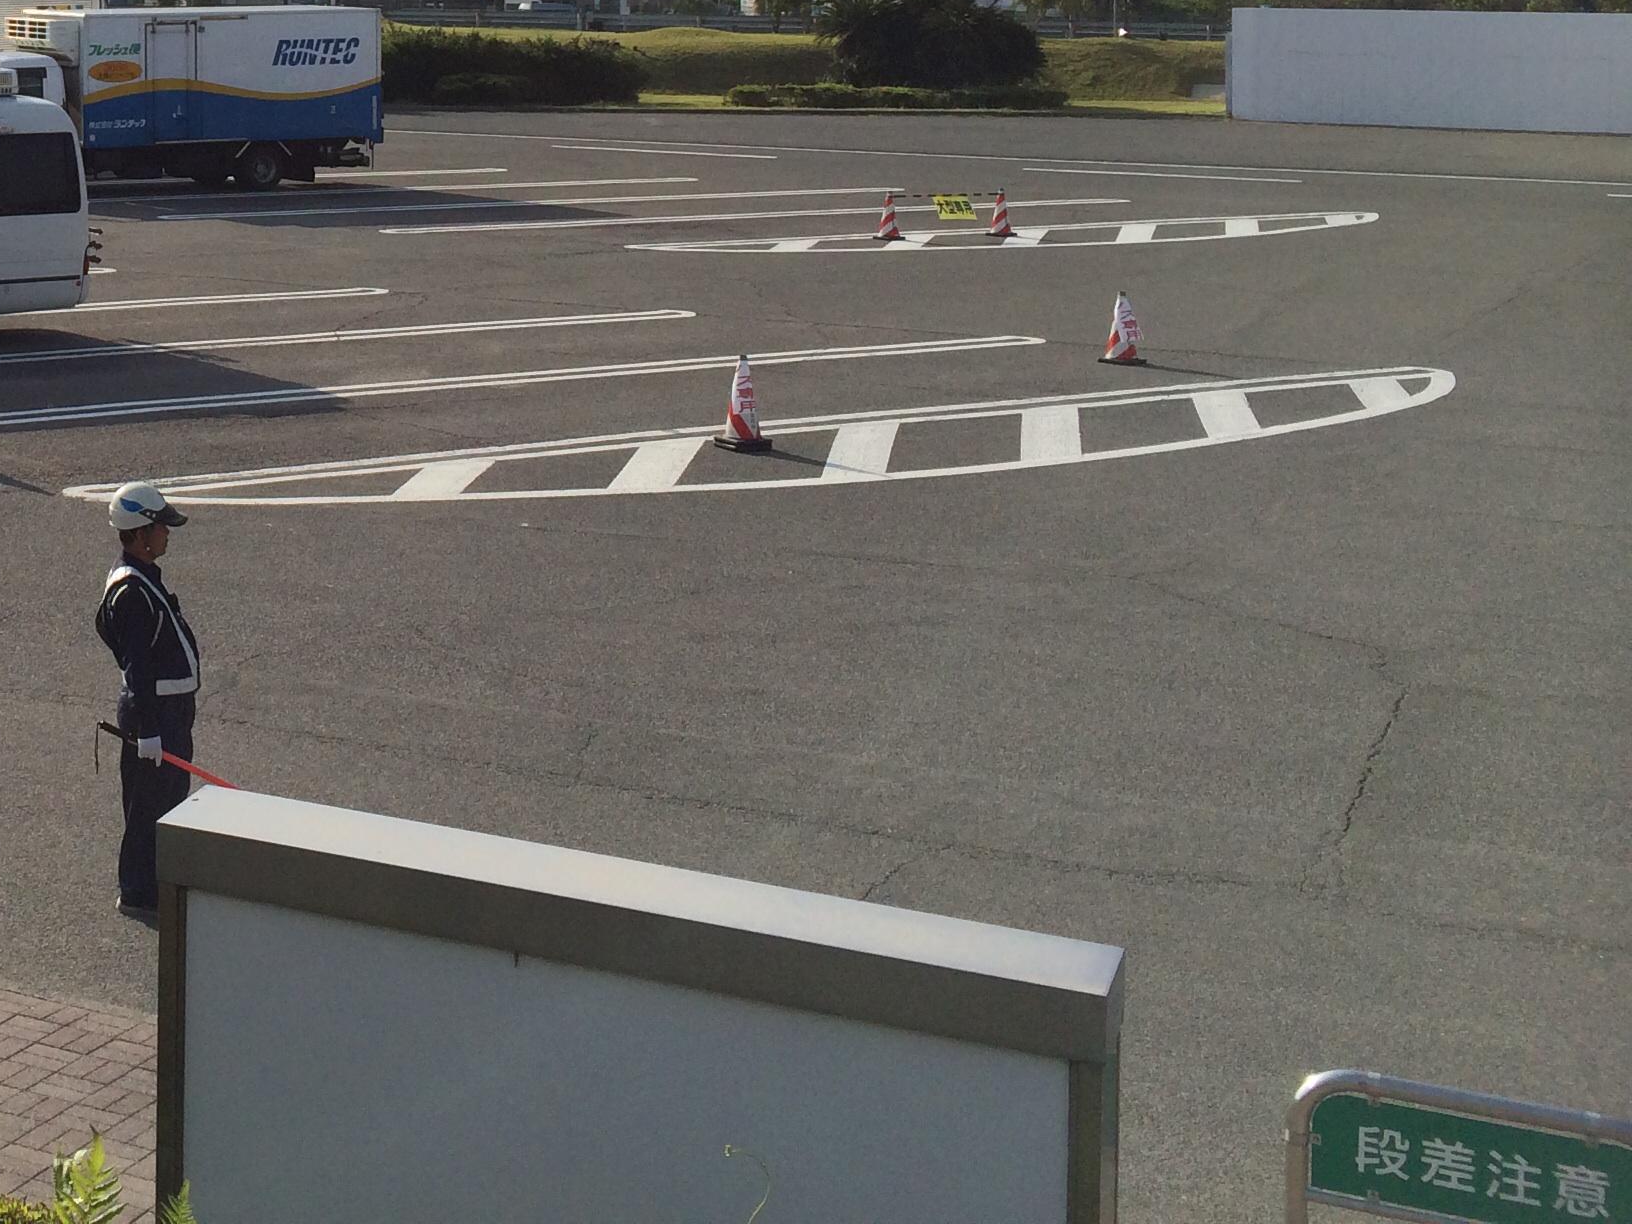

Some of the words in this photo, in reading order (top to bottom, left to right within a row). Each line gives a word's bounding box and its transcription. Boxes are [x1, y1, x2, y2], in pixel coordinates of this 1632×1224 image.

[88, 42, 141, 56] フレッシュ便
[271, 37, 360, 66] RUNTEC
[936, 199, 975, 215] 大型専用
[1354, 1126, 1611, 1219] 段差注意
